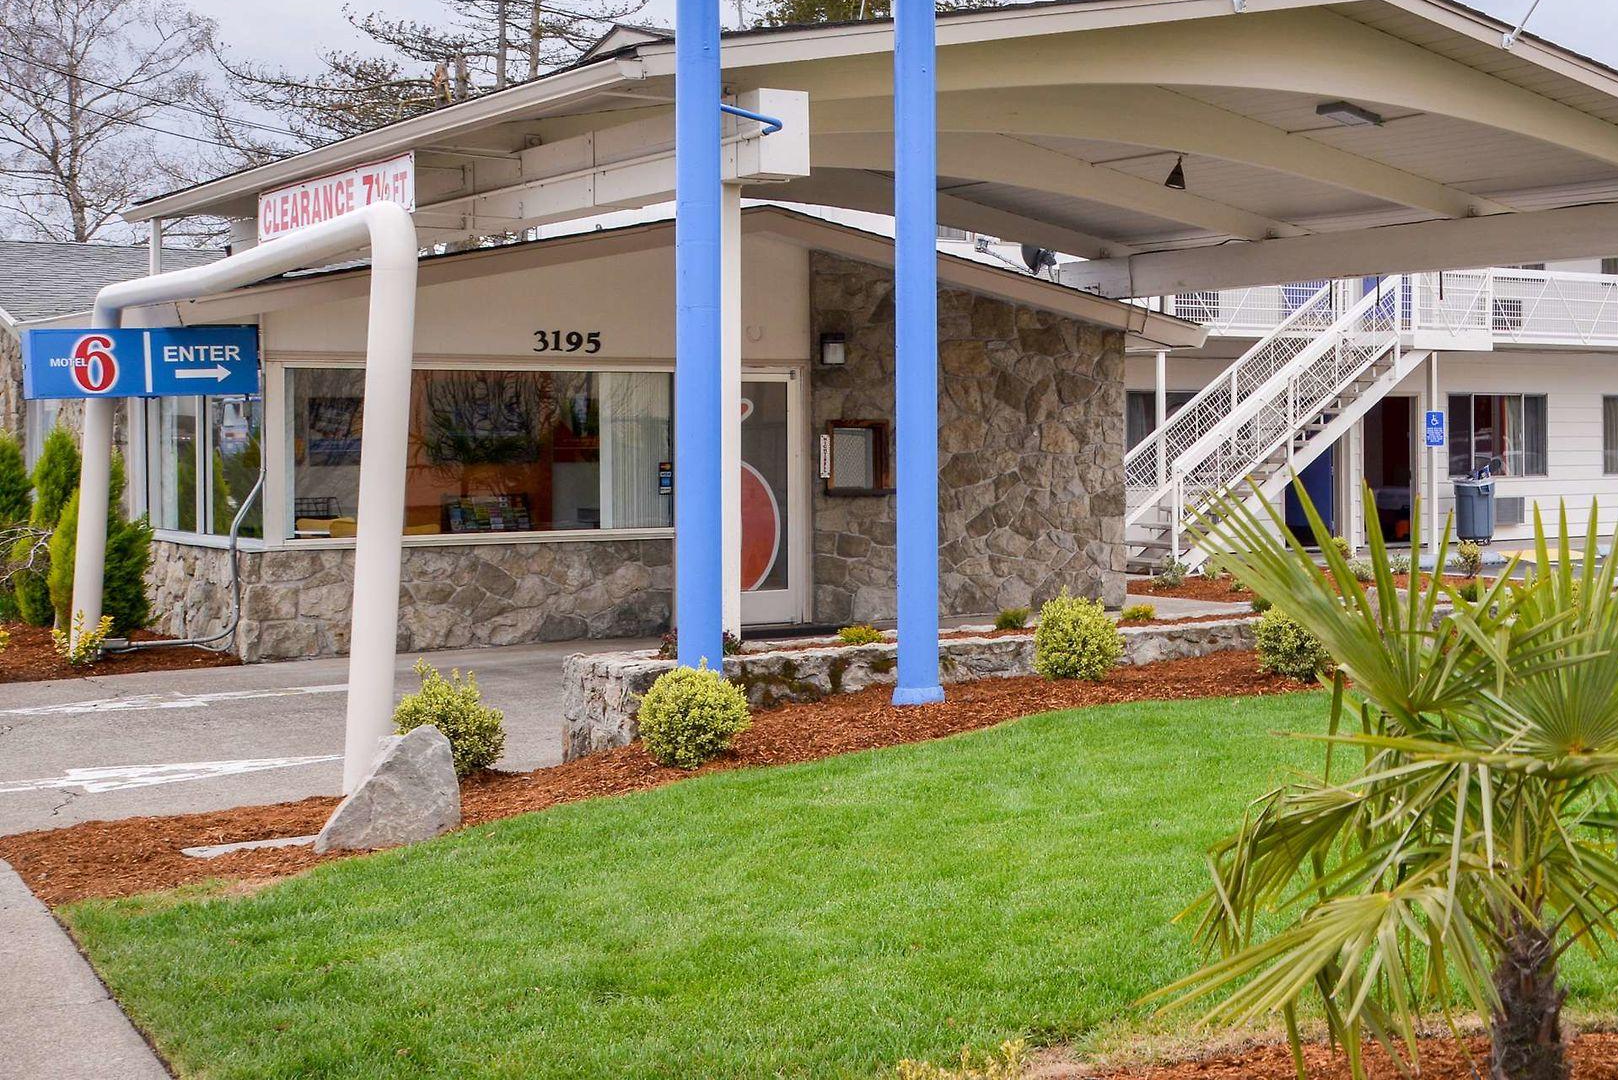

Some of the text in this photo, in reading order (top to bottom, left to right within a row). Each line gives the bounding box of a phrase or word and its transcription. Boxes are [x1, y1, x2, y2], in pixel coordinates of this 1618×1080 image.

[263, 177, 355, 235] CLEARANCE
[392, 170, 408, 204] FT
[162, 345, 242, 363] ENTER
[532, 329, 602, 354] 3195
[49, 335, 117, 392] MOTEL 6
